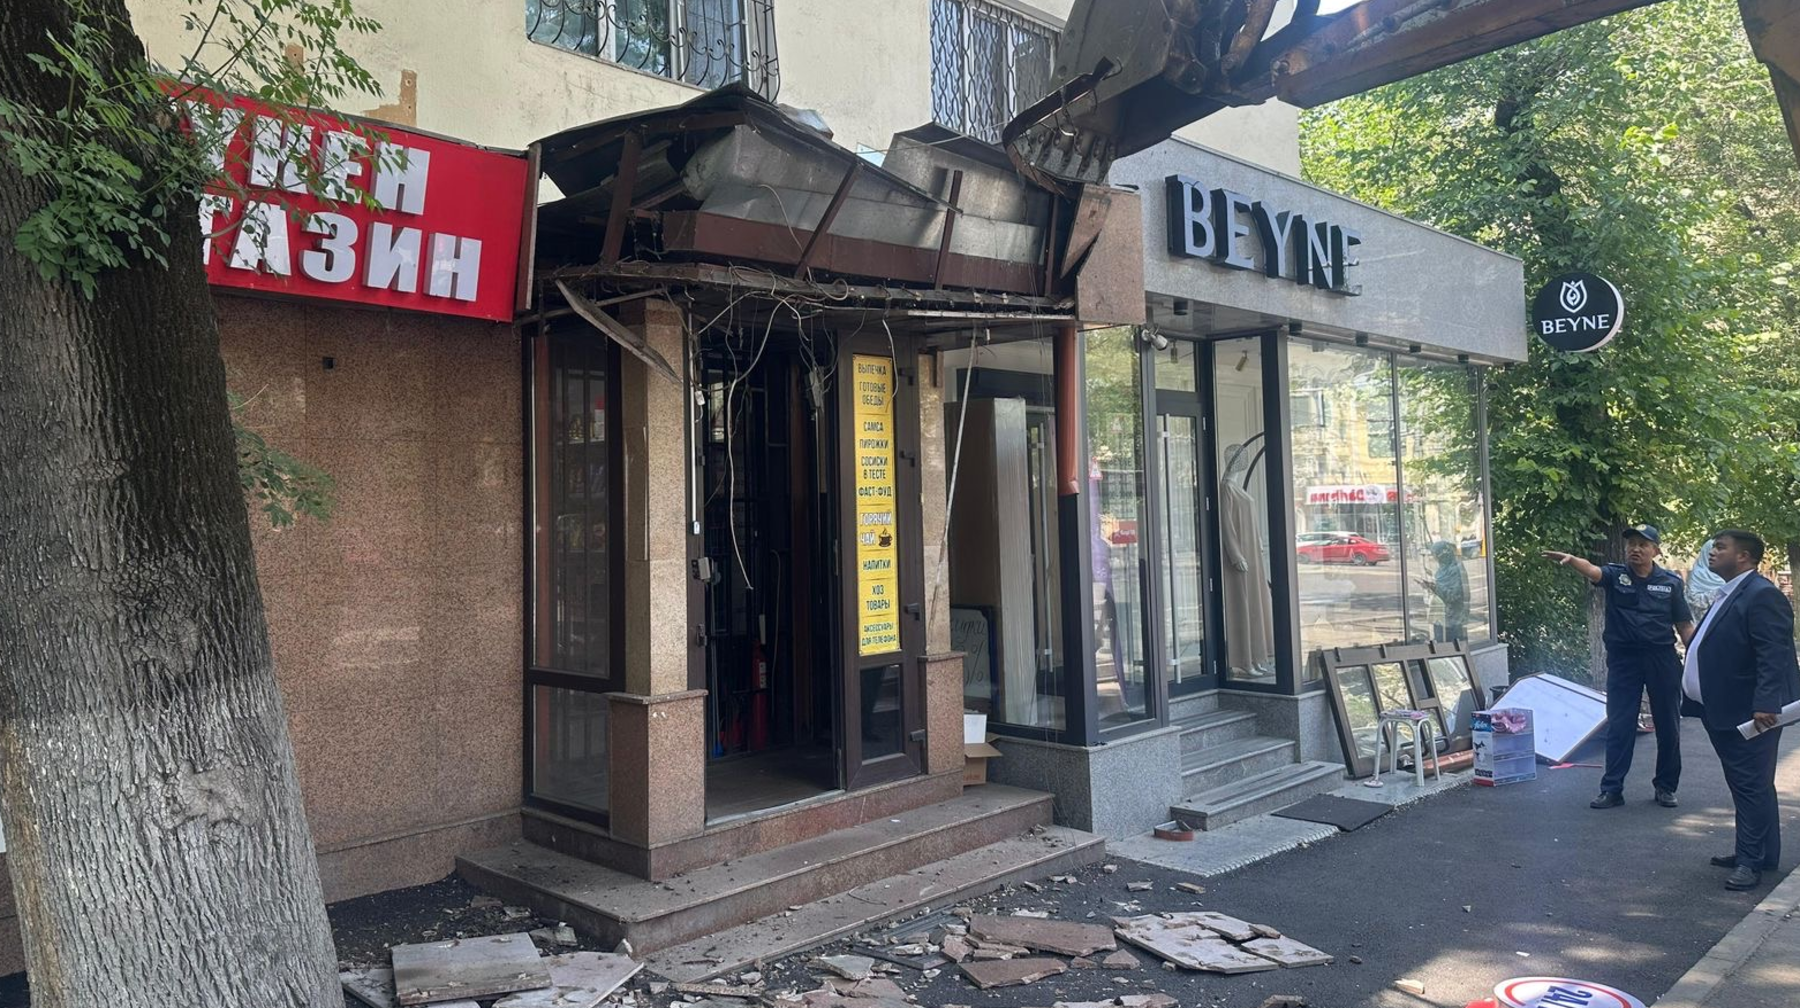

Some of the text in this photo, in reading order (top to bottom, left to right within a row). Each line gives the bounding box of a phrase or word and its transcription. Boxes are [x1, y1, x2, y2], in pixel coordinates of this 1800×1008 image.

[173, 99, 431, 215] ҮКЕН
[1165, 174, 1362, 296] BEYNE
[200, 193, 482, 302] ГАЗИН
[1541, 314, 1610, 335] BEYNE
[858, 363, 887, 376] ВЫПЕЧКА
[859, 381, 886, 393] ГОТОВЫЕ
[862, 394, 884, 406] ОБЕДЫ
[863, 421, 884, 432] САМСА
[859, 438, 889, 449] ПИРОЖКИ
[861, 455, 888, 467] СОСИСКИ
[863, 468, 886, 480] В ТЕСТЕ
[858, 485, 892, 498] ФАСТ-ФУД
[859, 510, 892, 526] ГОРЯЧИЙ
[860, 530, 876, 546] ЧАЙ
[862, 559, 891, 571] НАПИТКИ
[871, 584, 885, 596] ХОЗ
[866, 599, 891, 611] ТОВАРЫ
[863, 622, 894, 633] АКСЕССУАРЫ
[861, 633, 897, 647] ДЛЯ ТЕЛЕФОНА
[1537, 985, 1593, 1008] 24/
